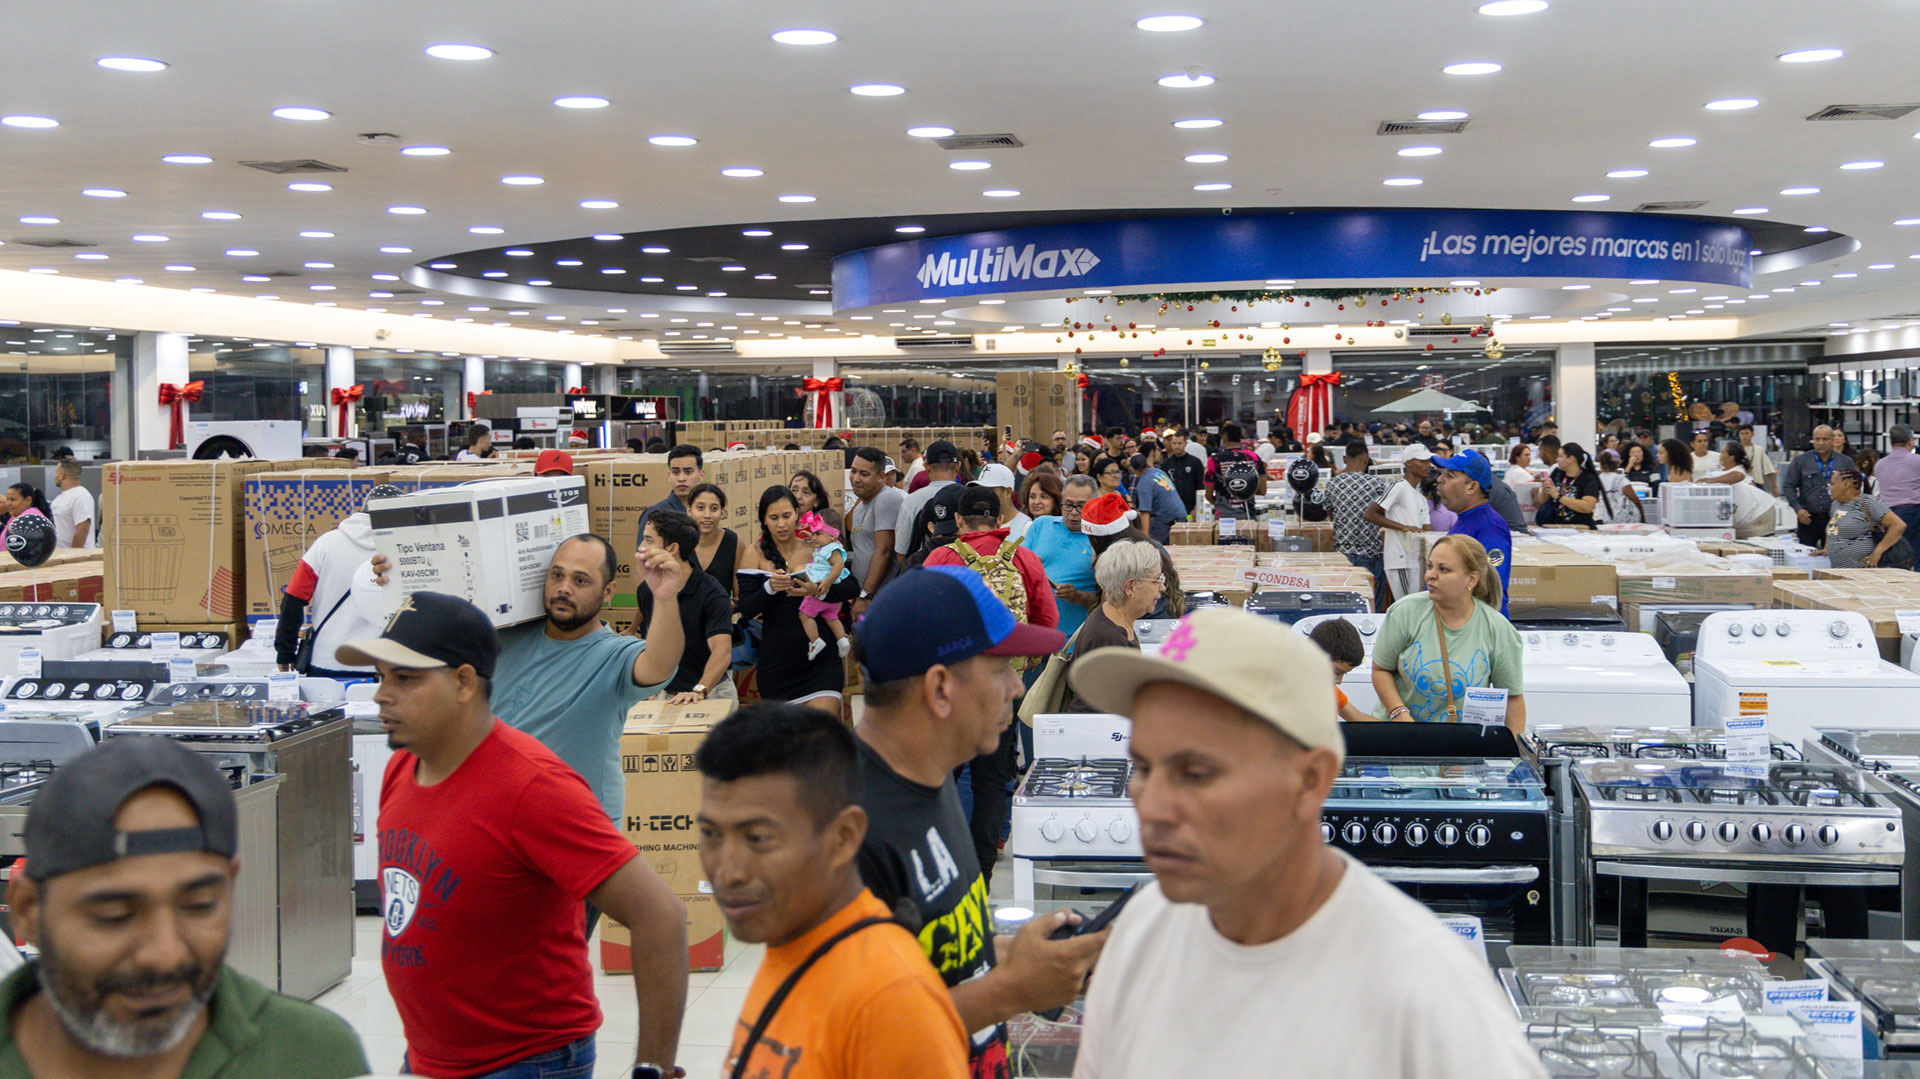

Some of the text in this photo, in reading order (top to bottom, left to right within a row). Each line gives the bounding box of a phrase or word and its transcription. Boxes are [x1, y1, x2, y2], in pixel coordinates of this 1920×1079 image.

[1420, 231, 1477, 262] ¡Las
[1482, 229, 1587, 263] mejores
[1591, 236, 1669, 260] marcas
[1671, 240, 1692, 261] en
[1702, 242, 1725, 265] solo
[922, 243, 1081, 288] MultiMax
[257, 522, 317, 535] OMEGA
[396, 541, 446, 555] Tipo Ventana
[1258, 572, 1311, 589] CONDESA
[1111, 732, 1123, 742] SJ
[910, 826, 960, 902] LA
[386, 871, 418, 905] NETS
[390, 944, 428, 967] YORK
[1767, 990, 1820, 1000] PRECIO
